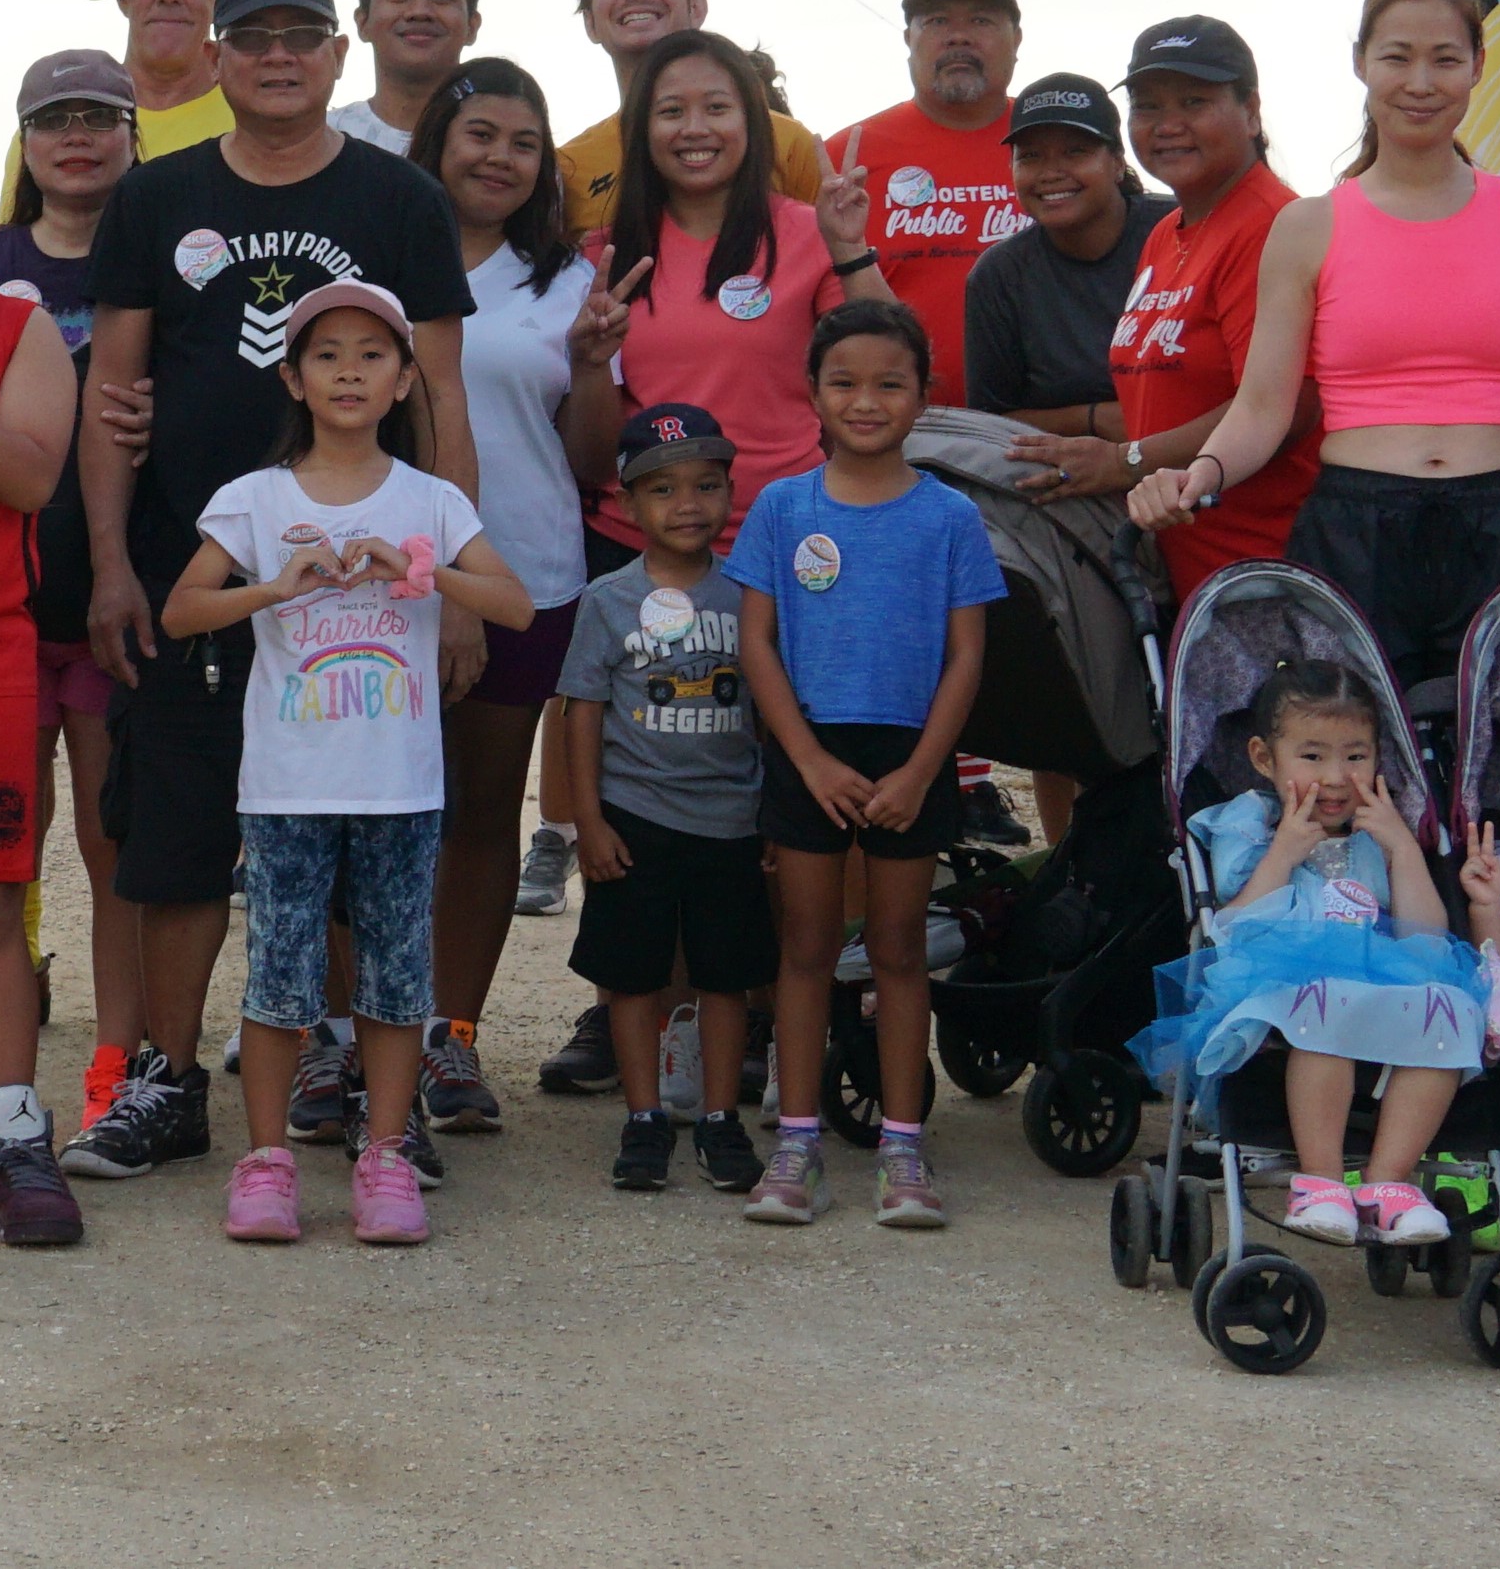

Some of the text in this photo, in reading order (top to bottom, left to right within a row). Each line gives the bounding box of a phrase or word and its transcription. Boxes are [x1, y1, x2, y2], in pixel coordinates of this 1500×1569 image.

[885, 205, 968, 239] Public
[278, 667, 424, 722] RAINBOW
[645, 704, 743, 734] LEGEND
